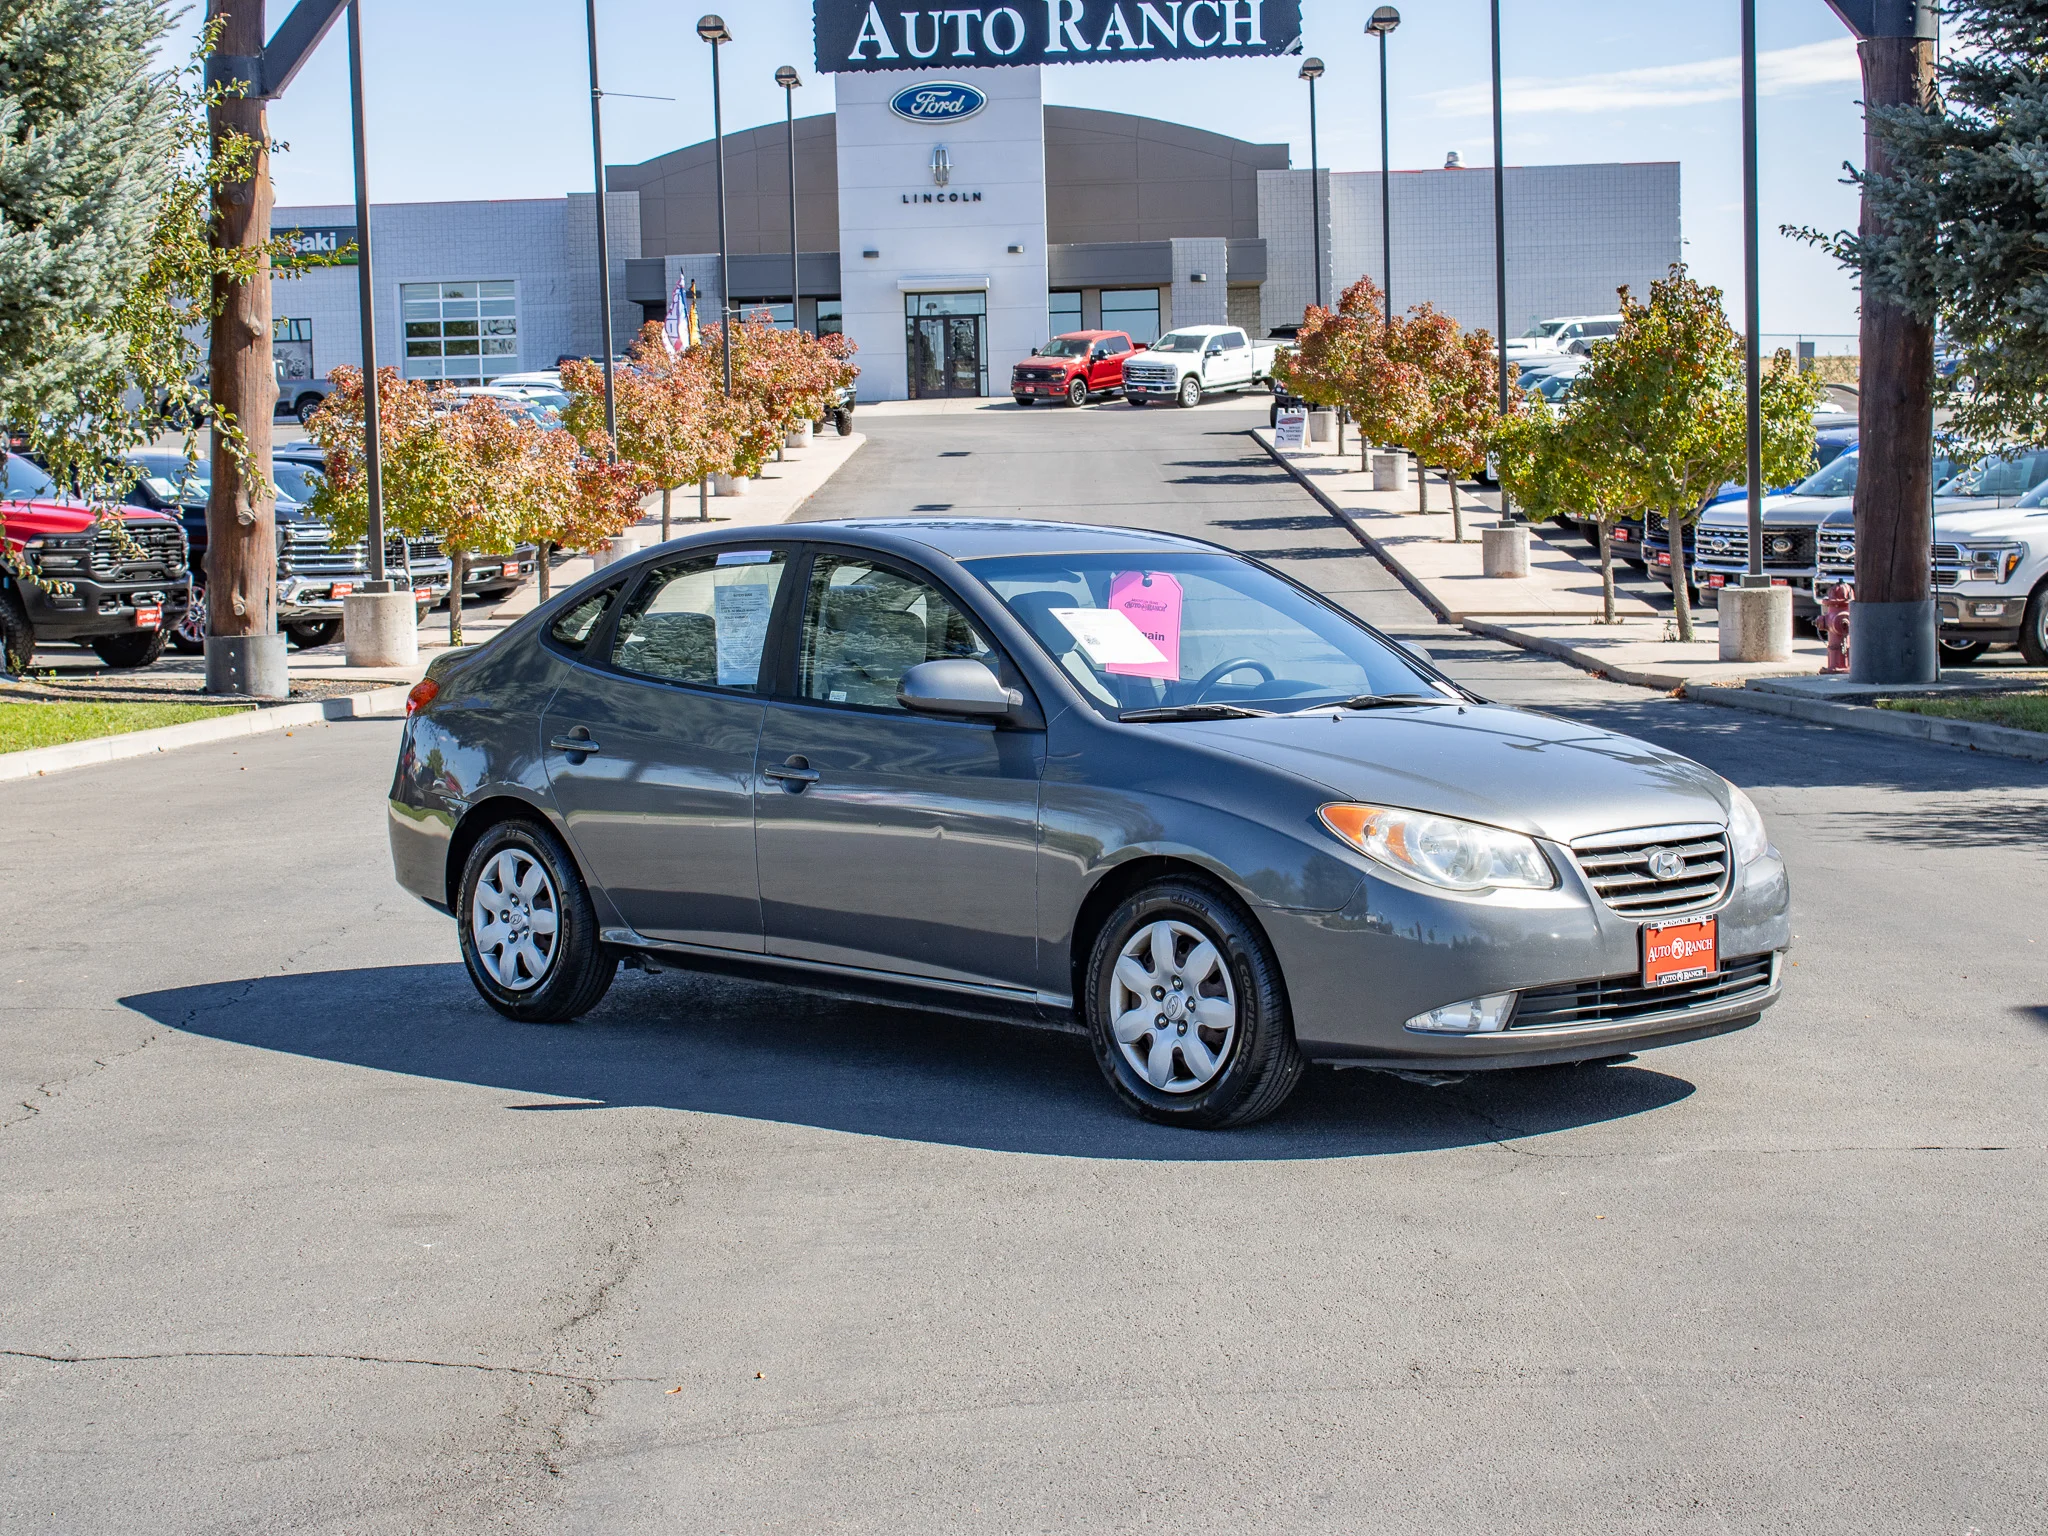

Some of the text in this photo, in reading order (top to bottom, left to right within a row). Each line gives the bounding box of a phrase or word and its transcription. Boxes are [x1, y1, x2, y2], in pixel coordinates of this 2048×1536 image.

[848, 0, 1267, 61] AUTO RANCH
[911, 90, 966, 115] Ford
[902, 192, 983, 205] LINCOLN
[282, 232, 337, 252] saki
[1170, 893, 1209, 915] CALDERA
[1647, 939, 1712, 963] AUTO RANCH
[1661, 970, 1702, 985] AUTO RANCH
[1235, 963, 1255, 1075] CONFIDENCE
